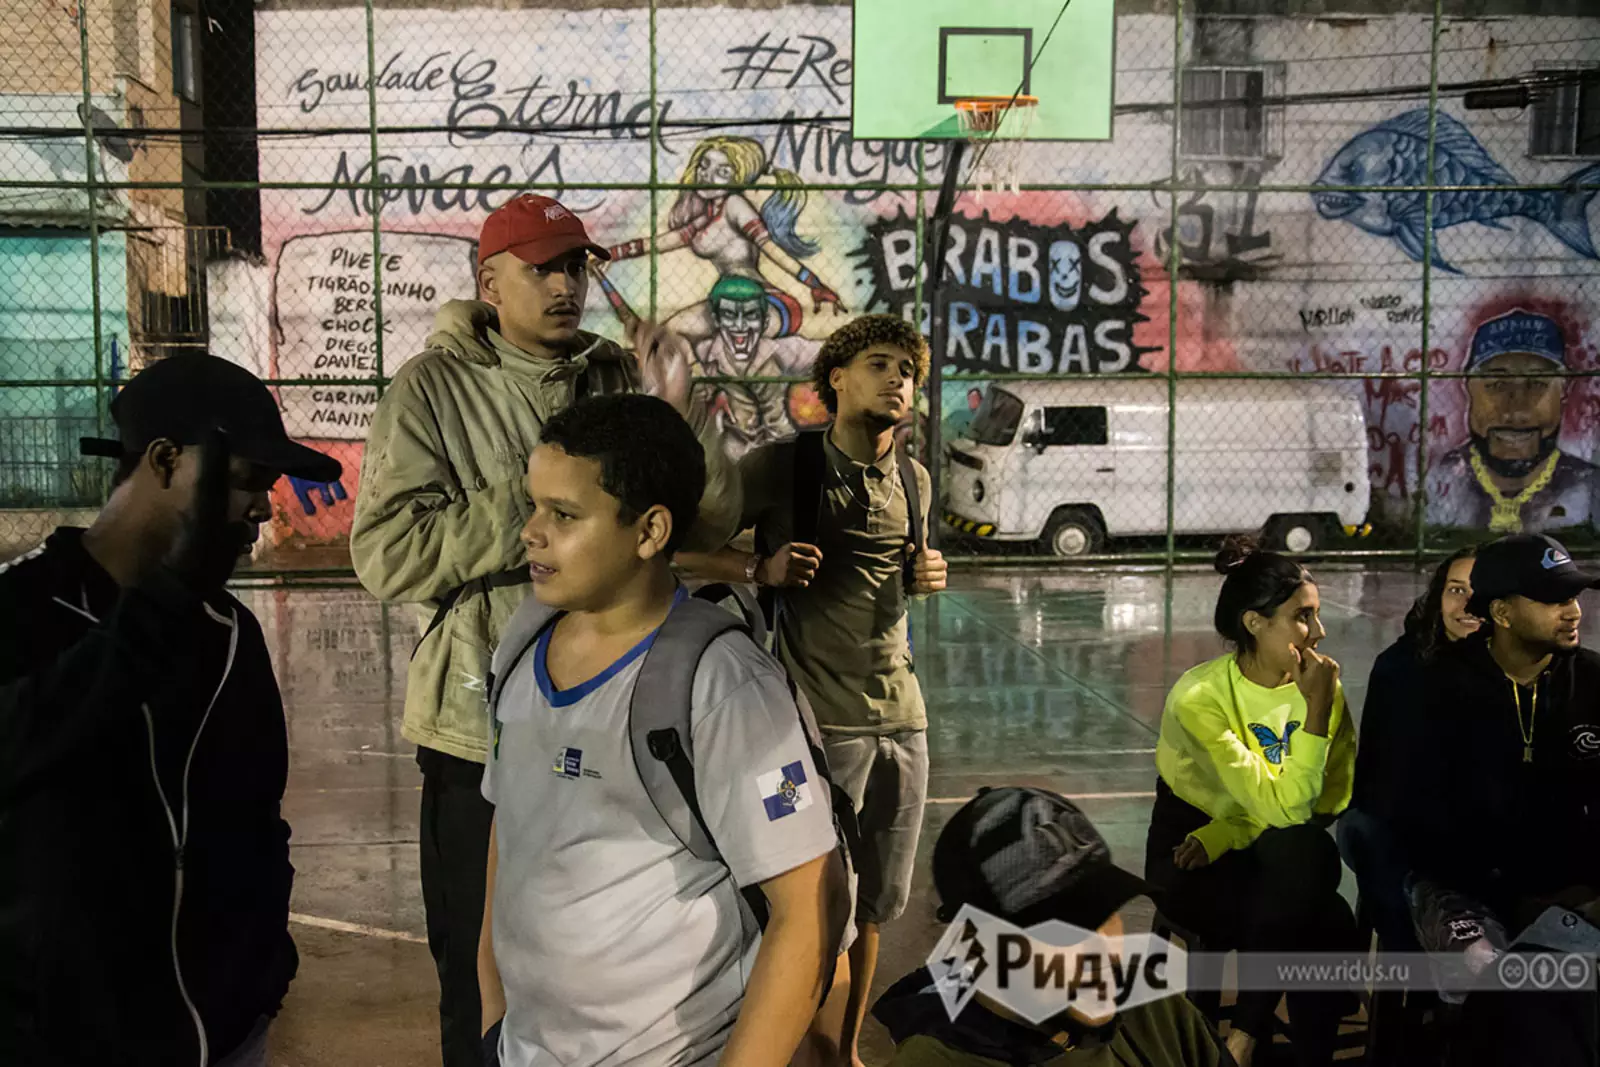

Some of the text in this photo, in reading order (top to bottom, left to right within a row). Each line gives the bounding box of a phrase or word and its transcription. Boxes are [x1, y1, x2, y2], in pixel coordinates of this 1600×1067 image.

[448, 50, 678, 154] Eterna
[766, 110, 974, 204] Ningue
[330, 247, 402, 272] PIVETE
[314, 354, 379, 371] DANIEL
